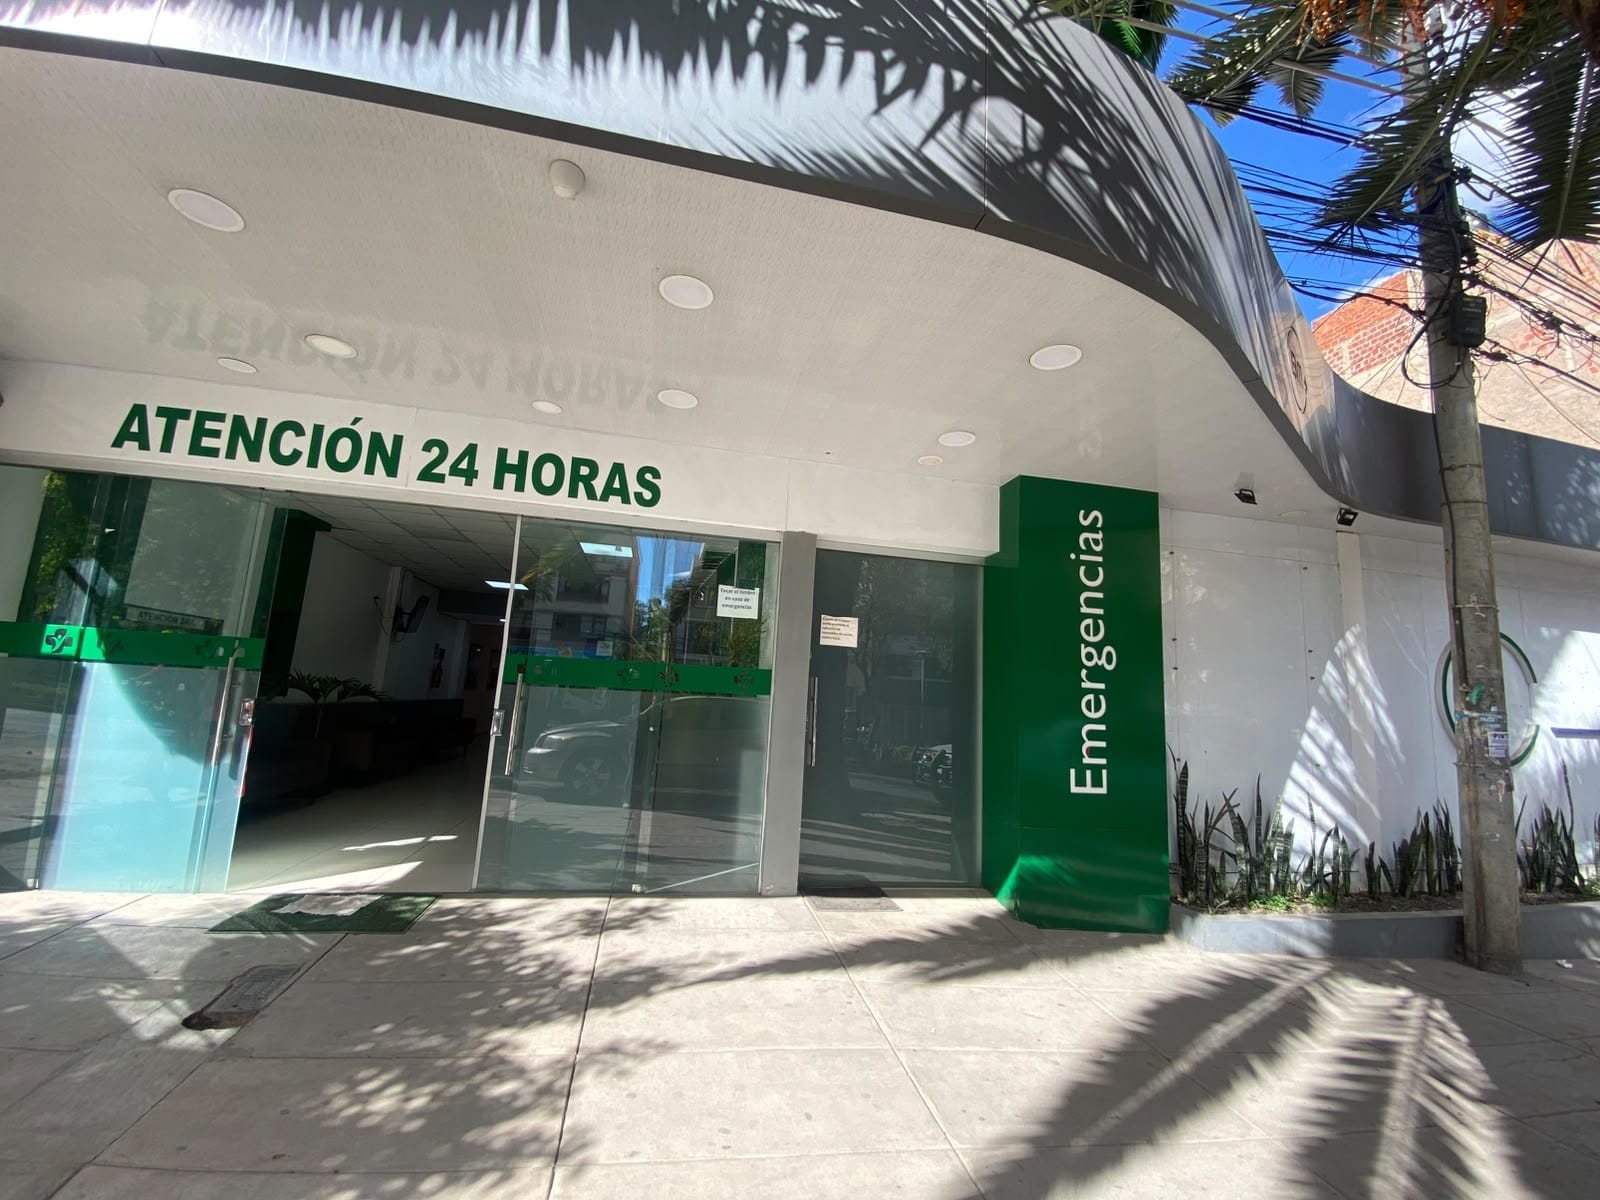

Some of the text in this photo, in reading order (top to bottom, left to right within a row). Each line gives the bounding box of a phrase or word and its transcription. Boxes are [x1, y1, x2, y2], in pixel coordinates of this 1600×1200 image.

[110, 402, 663, 508] ATENCIÓN 24 HORAS
[1069, 509, 1117, 795] Emergencias
